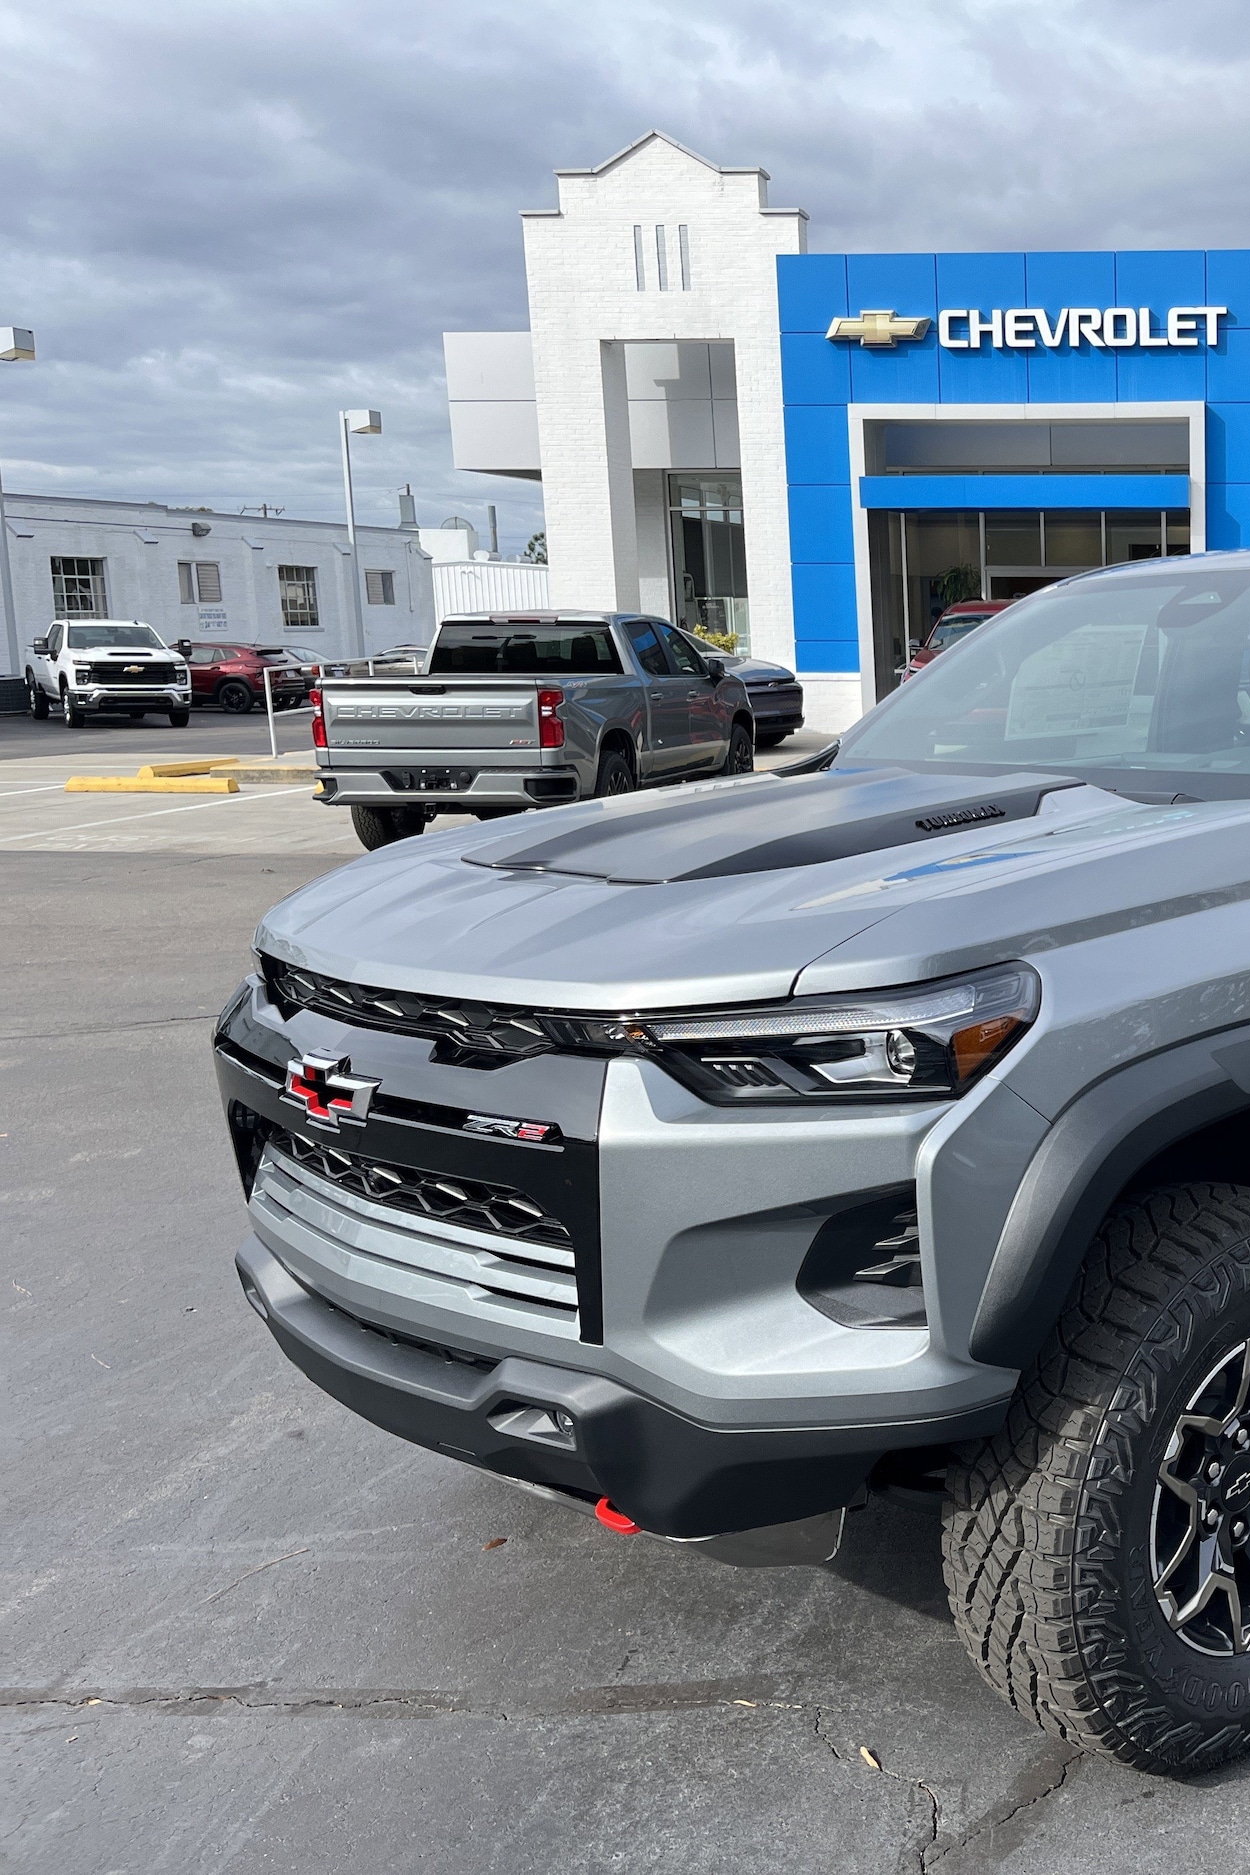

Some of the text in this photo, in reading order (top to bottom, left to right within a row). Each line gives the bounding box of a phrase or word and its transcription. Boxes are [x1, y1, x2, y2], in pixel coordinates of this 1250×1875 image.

[938, 306, 1228, 348] CHEVROLET
[337, 705, 523, 719] CHEVROLET
[462, 1114, 551, 1141] ZR2
